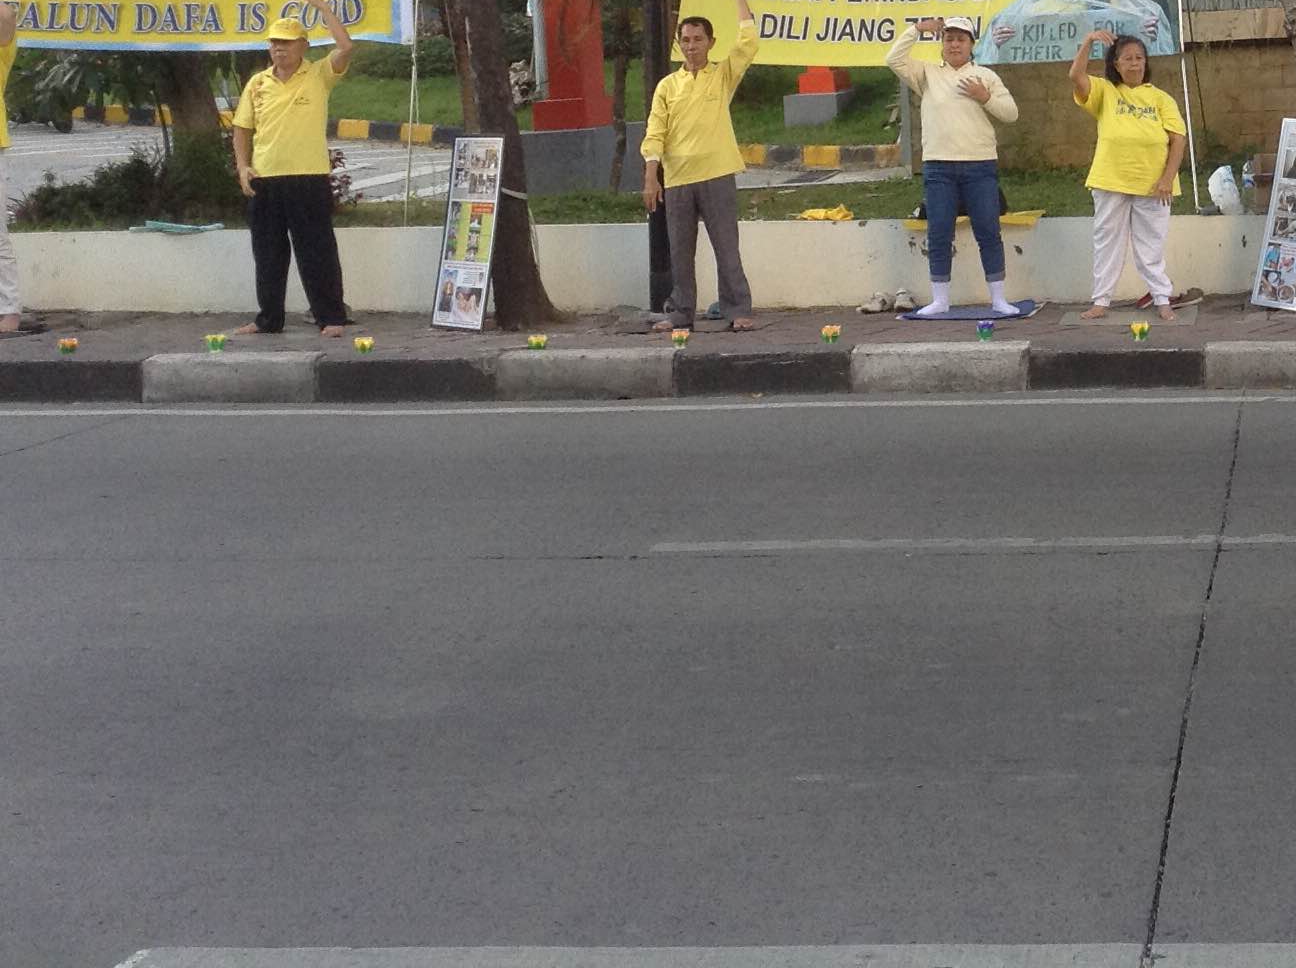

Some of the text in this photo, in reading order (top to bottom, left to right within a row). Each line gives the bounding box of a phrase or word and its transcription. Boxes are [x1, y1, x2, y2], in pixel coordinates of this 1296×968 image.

[135, 2, 224, 32] DAFA
[237, 2, 267, 32] IS
[750, 11, 810, 41] DILI
[816, 17, 895, 42] JIANG
[1010, 45, 1063, 62] THEIR
